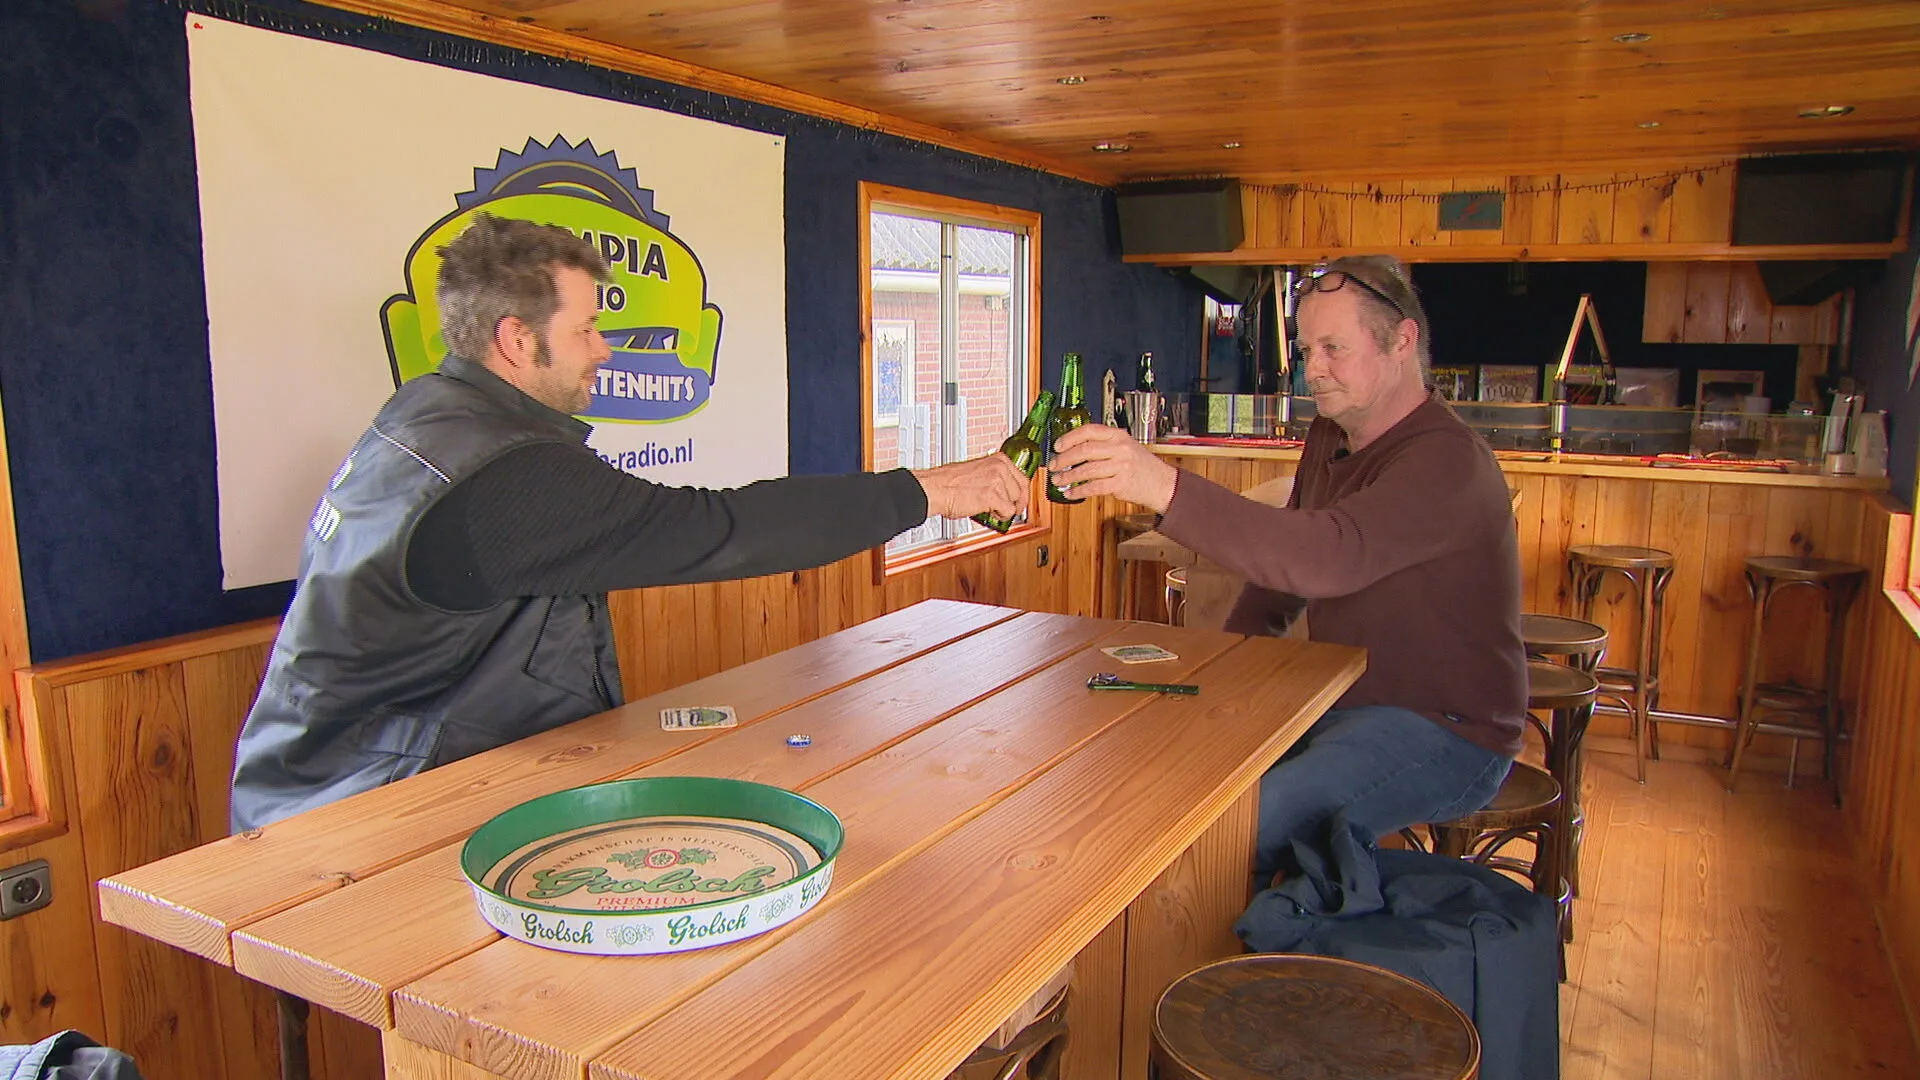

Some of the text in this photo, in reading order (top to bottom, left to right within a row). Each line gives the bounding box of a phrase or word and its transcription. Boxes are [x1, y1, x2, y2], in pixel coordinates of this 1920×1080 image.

[526, 865, 776, 900] Grolsch
[597, 897, 696, 906] PREMIUM
[521, 912, 594, 945] Grolsch
[667, 903, 750, 946] Grolsch
